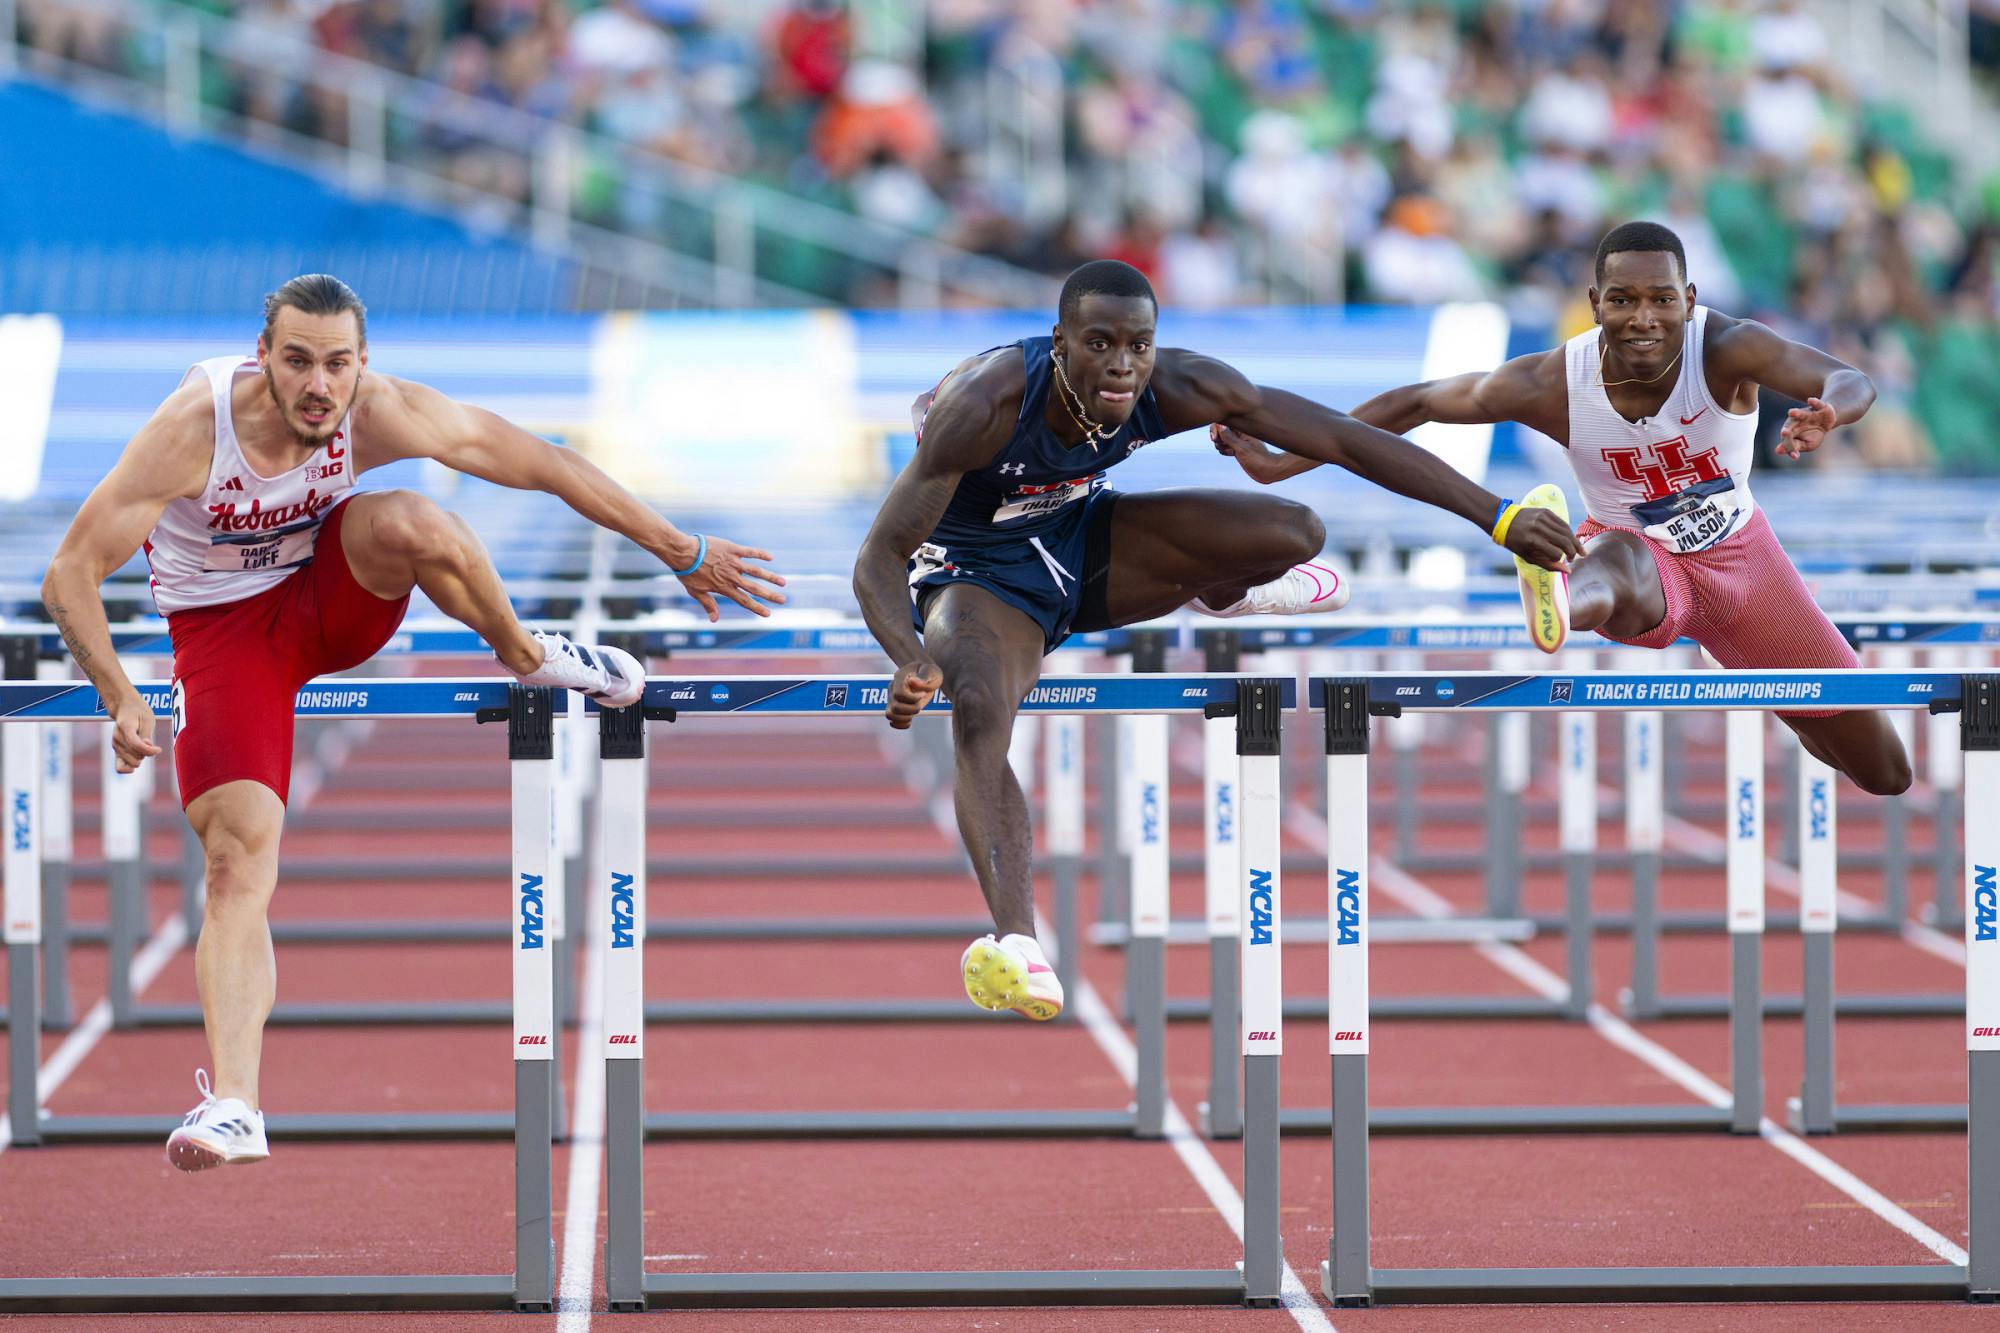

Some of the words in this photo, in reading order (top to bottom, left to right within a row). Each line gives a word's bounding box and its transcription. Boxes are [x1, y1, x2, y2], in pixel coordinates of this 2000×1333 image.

[243, 549, 279, 569] LUFF
[1182, 688, 1208, 697] GILL
[1395, 687, 1421, 695] GILL
[1585, 684, 1633, 699] TRACK
[1636, 684, 1647, 699] &
[1649, 684, 1691, 699] FIELD
[1694, 683, 1822, 699] CHAMPIONSHIPS
[1907, 683, 1933, 692] GILL
[294, 692, 369, 708] IONSHIPS
[454, 693, 480, 701] GILL
[670, 691, 696, 700] GILL
[860, 687, 887, 704] TRA
[1250, 868, 1273, 945] NCAA
[1336, 868, 1360, 945] NCAA
[1974, 864, 1997, 941] NCAA
[521, 872, 544, 950] NCAA
[611, 872, 634, 949] NCAA
[518, 1035, 548, 1045] GILL
[608, 1035, 637, 1044] GILL
[1248, 1031, 1276, 1041] GILL
[1334, 1031, 1363, 1041] GILL
